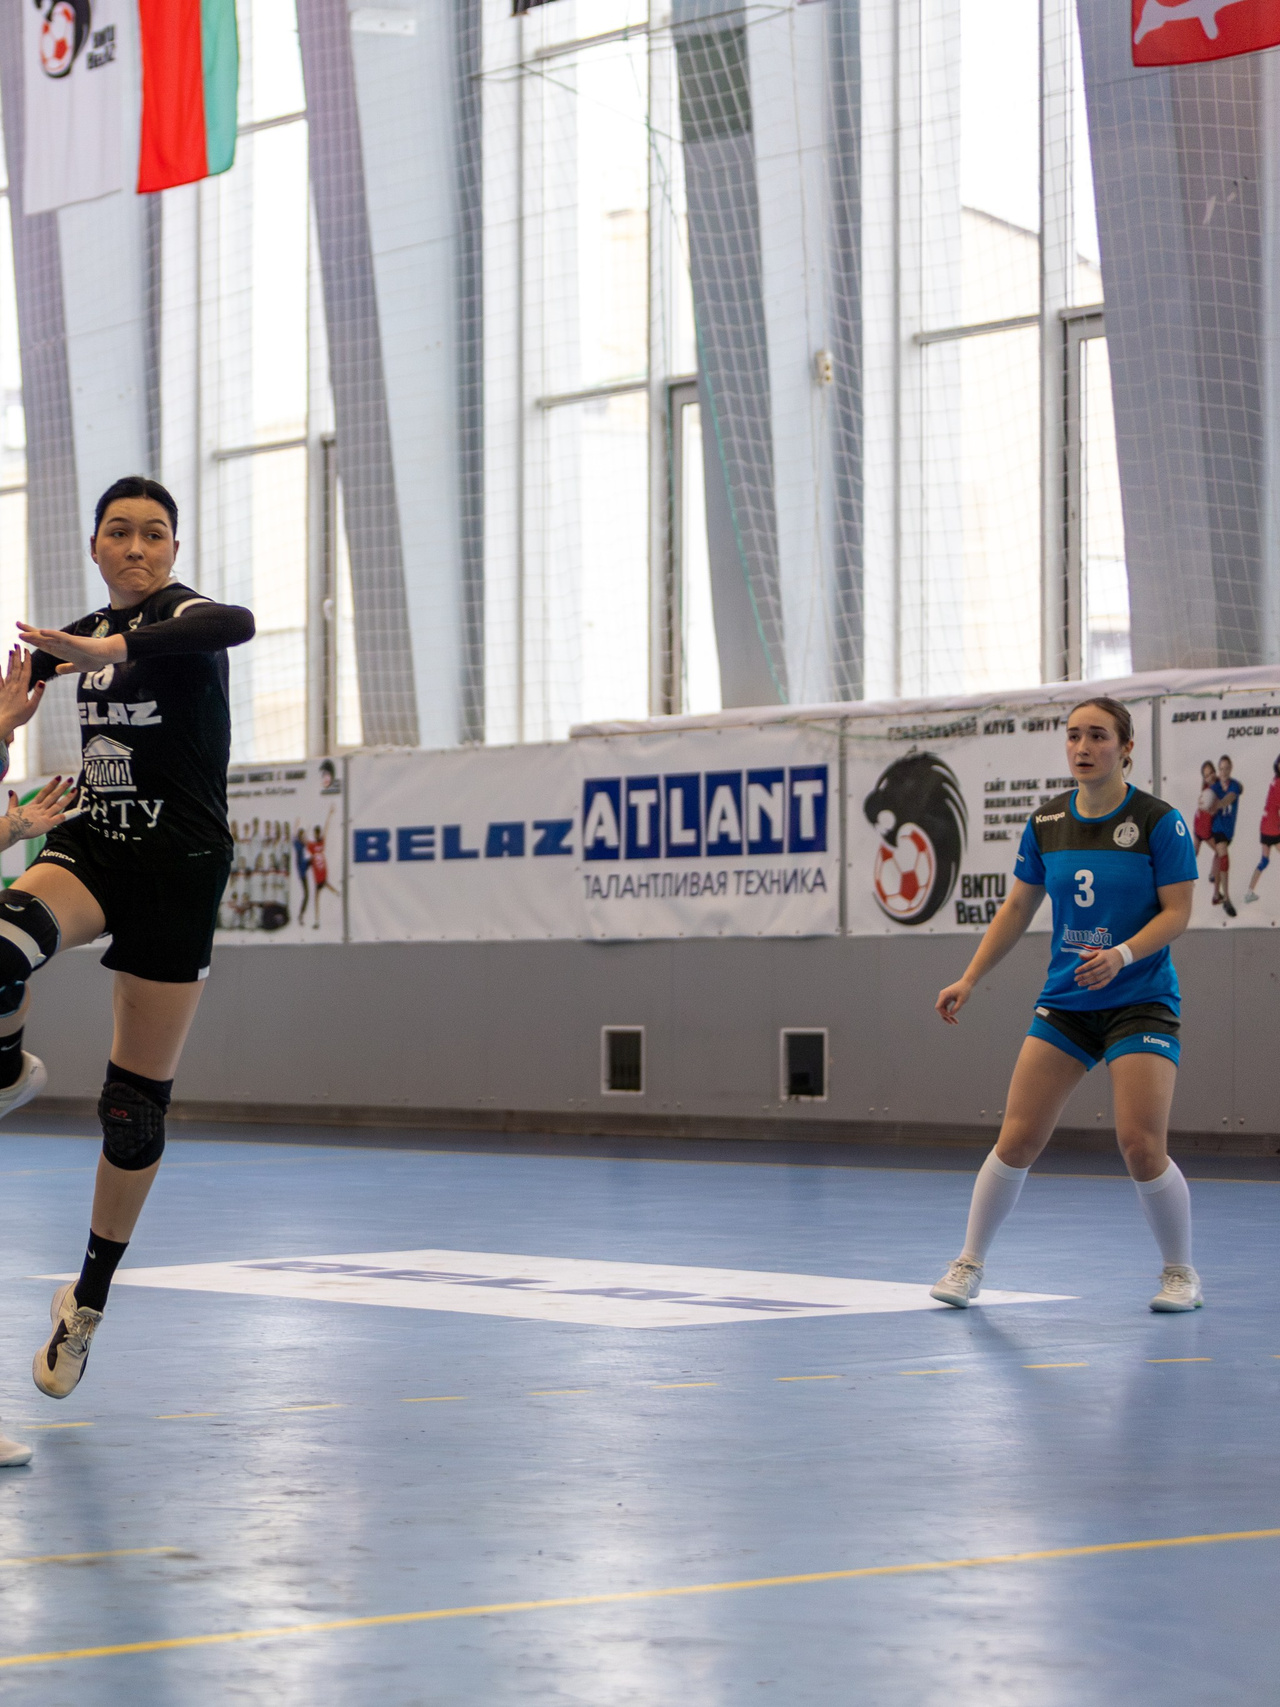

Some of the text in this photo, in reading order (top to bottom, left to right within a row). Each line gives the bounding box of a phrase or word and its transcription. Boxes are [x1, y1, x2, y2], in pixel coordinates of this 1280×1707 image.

[78, 700, 163, 727] ELAZ
[1227, 726, 1264, 739] ДЮСШ
[583, 777, 825, 851] ATLANT
[1035, 811, 1066, 825] Kempa
[353, 818, 575, 864] BELAZ
[583, 867, 828, 899] ТАЛАНТЛИВАЯ ТЕХНИКА
[961, 874, 1007, 898] BNTU
[1073, 868, 1096, 908] 3
